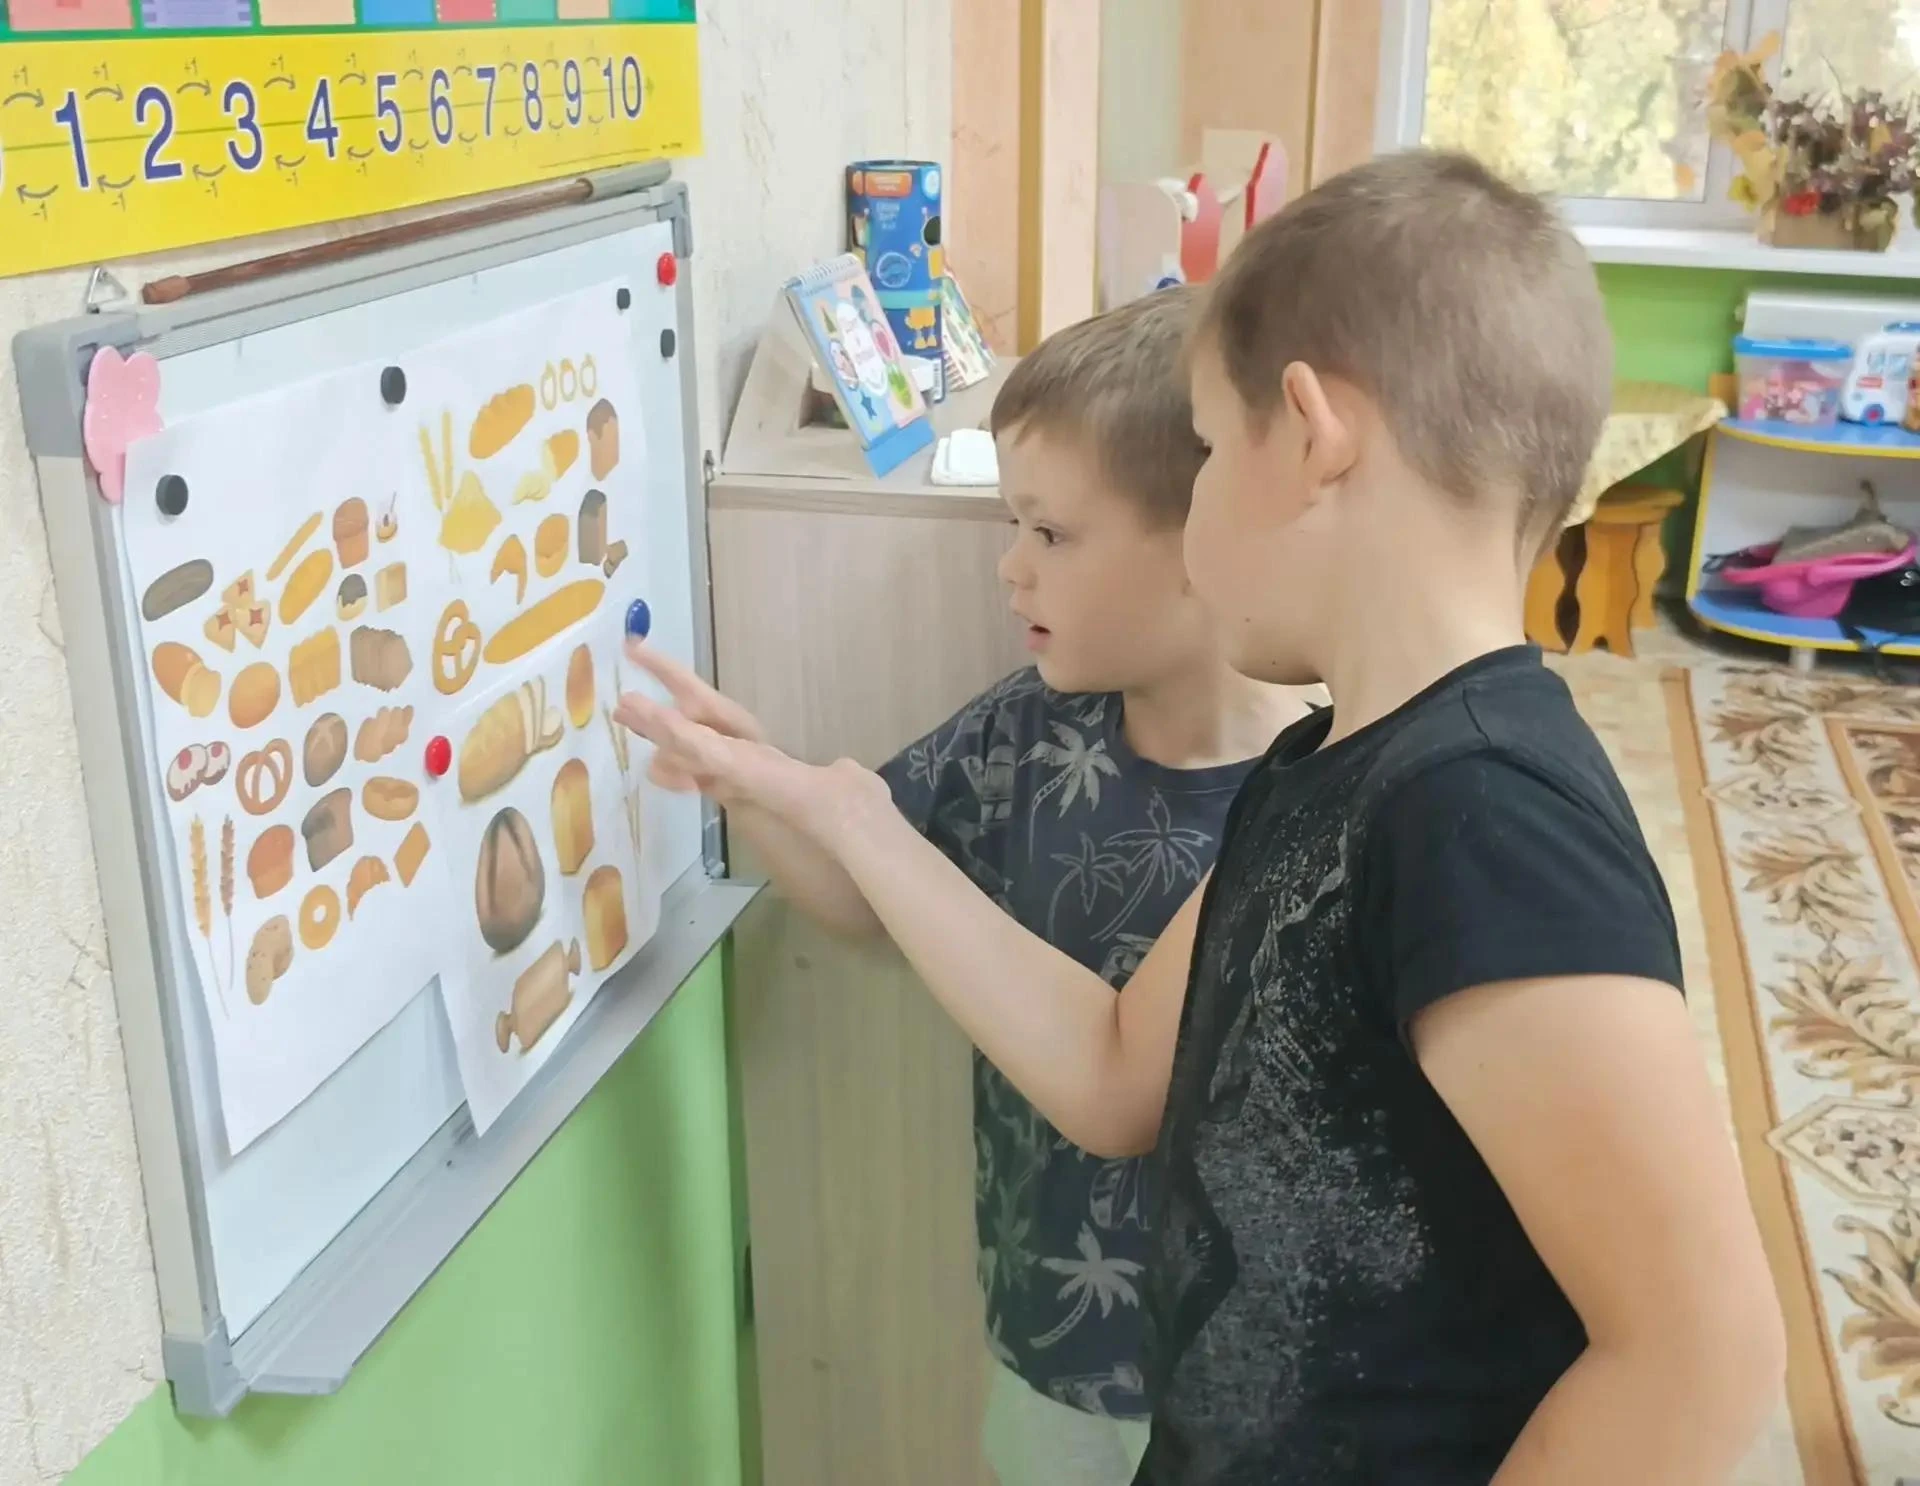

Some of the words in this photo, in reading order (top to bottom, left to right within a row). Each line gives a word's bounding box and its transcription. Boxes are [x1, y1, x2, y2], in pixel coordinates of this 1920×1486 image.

[12, 64, 28, 86] +1
[92, 61, 109, 81] +1
[184, 56, 198, 75] +1
[55, 90, 90, 188] 1
[135, 85, 184, 181] 2
[223, 81, 263, 170] 3
[306, 78, 339, 158] 4
[376, 74, 402, 153] 5
[430, 68, 453, 145] 6
[476, 66, 496, 137] 7
[522, 61, 543, 132] 8
[563, 59, 582, 125] 9
[602, 55, 642, 119] 10
[33, 202, 48, 221] -1
[111, 192, 126, 212] -1
[205, 180, 218, 198] -1
[285, 171, 298, 186] -1
